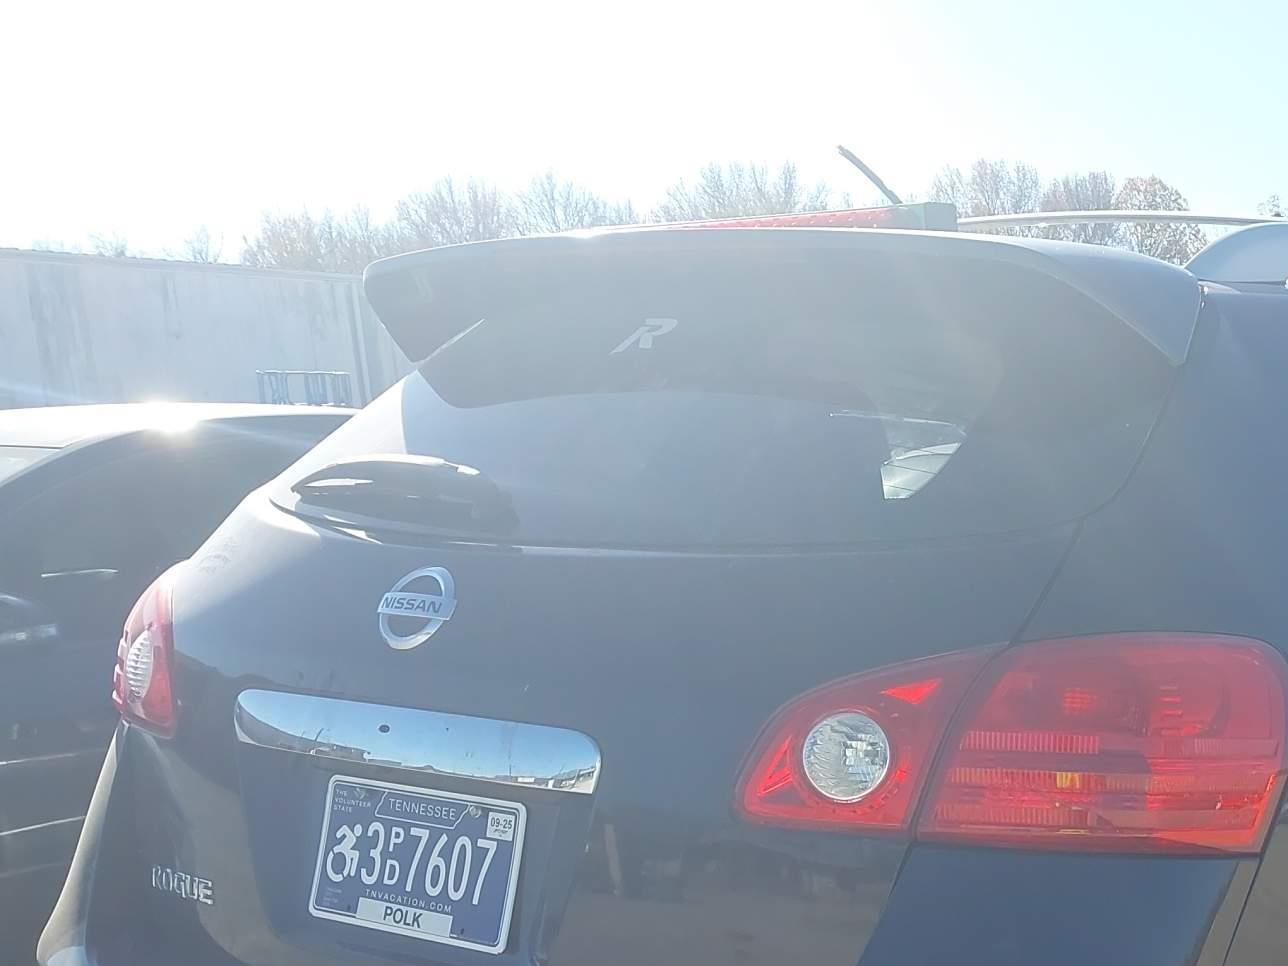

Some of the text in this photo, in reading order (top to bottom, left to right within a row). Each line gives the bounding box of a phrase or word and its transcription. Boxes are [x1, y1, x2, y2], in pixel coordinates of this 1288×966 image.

[381, 596, 442, 614] NISSAN
[389, 798, 457, 820] TENNESSEE
[490, 816, 513, 830] 09-25
[152, 866, 214, 905] ROGUE
[365, 888, 452, 913] TNVACATION.COM
[383, 905, 424, 929] POLK
